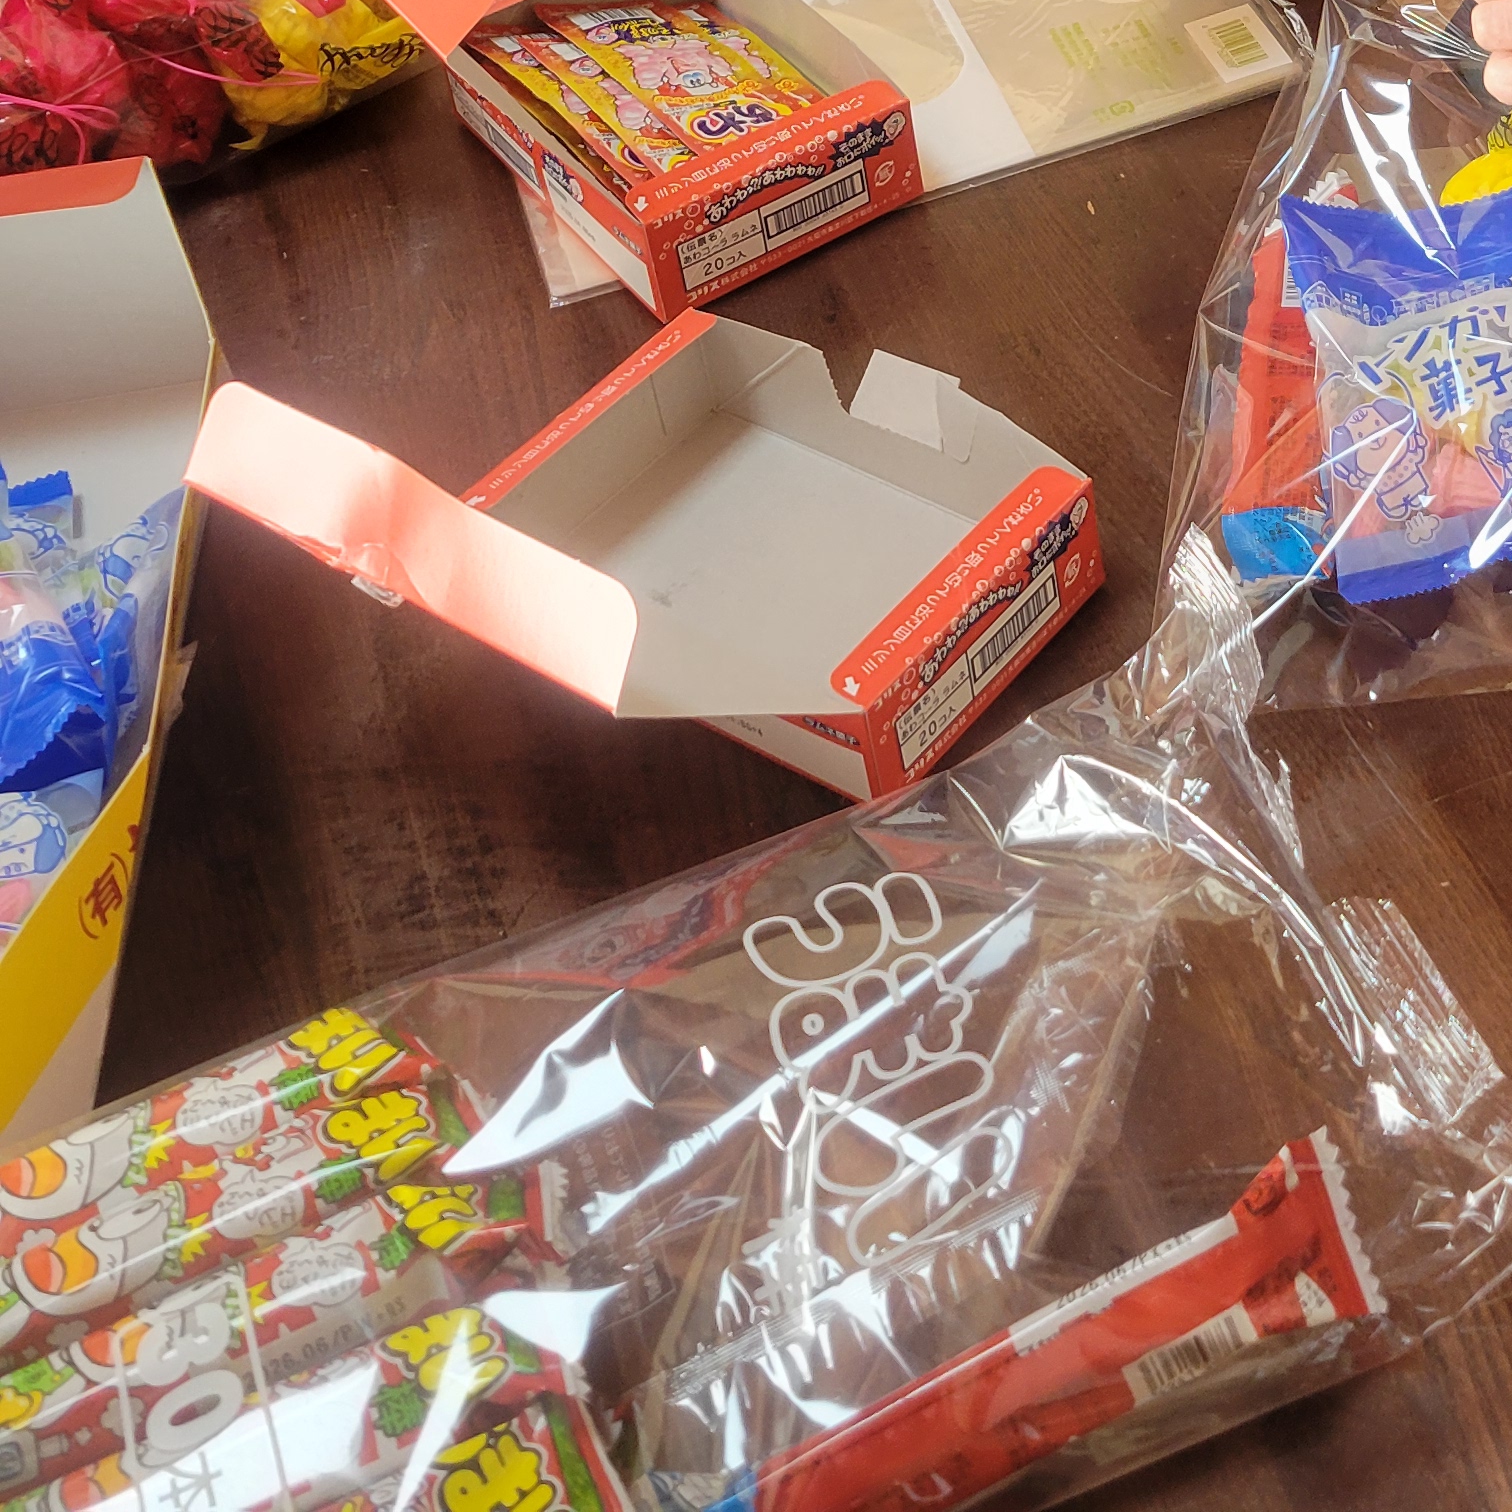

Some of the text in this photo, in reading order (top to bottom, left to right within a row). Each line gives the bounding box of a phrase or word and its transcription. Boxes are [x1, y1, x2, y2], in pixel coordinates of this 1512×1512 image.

[703, 251, 747, 276] 20コ入
[919, 705, 957, 748] 20コ入
[78, 824, 140, 940] (有)
